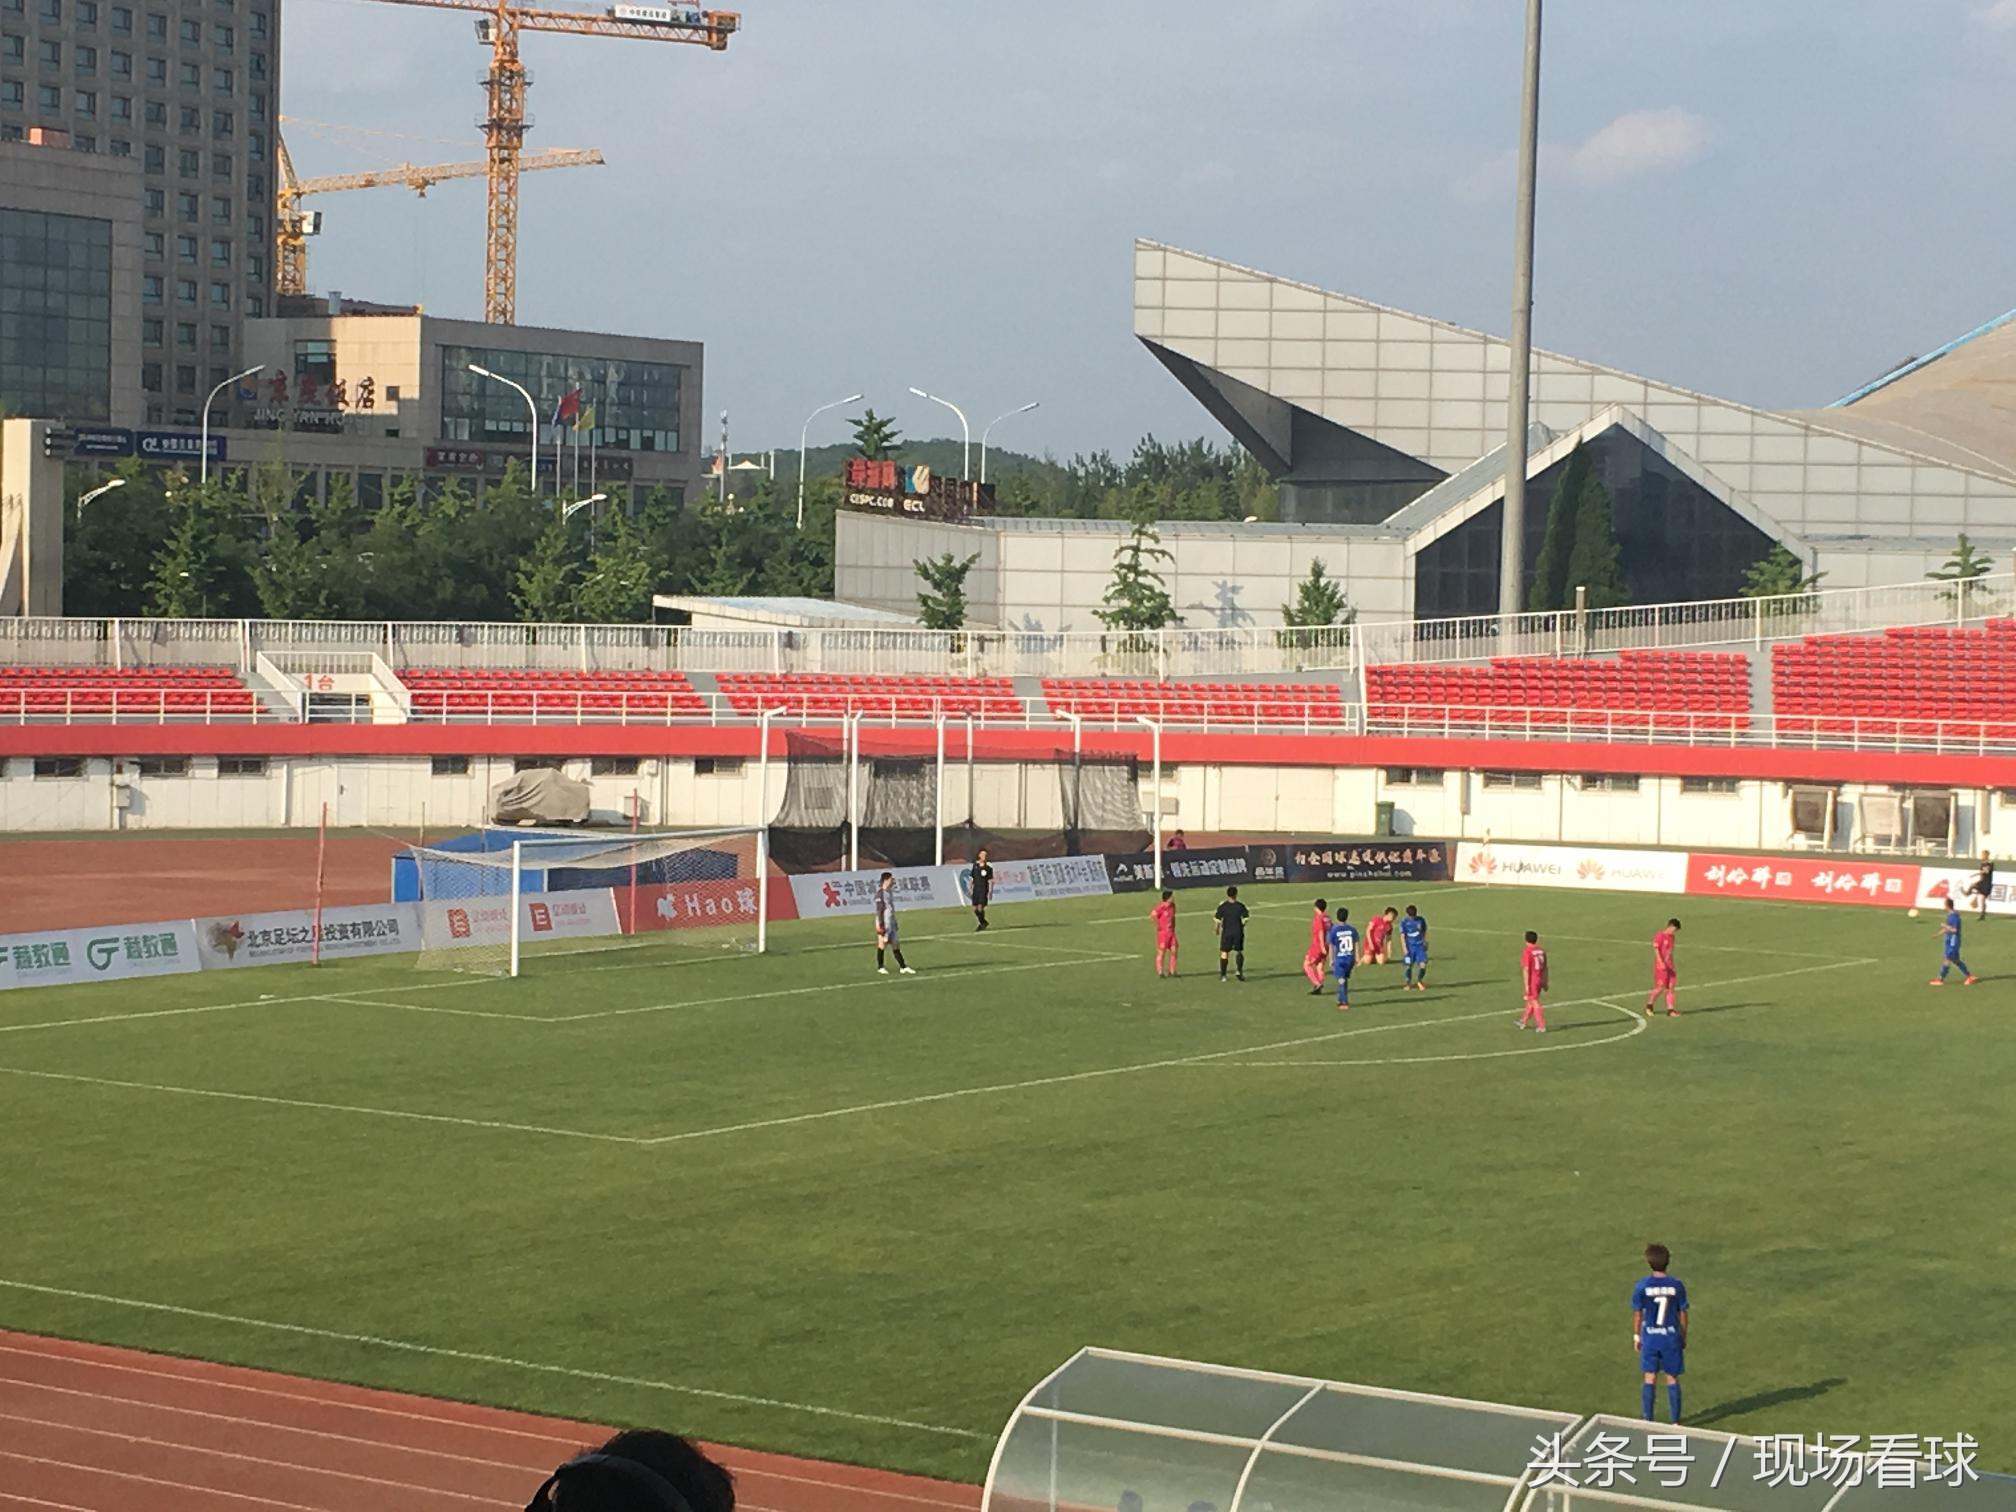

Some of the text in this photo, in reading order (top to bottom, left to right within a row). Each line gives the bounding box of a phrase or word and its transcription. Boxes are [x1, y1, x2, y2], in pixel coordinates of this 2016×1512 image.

[1502, 860, 1562, 875] HUAWEI
[1611, 868, 1668, 880] HUAWE
[1338, 936, 1353, 952] 20
[1653, 1296, 1668, 1325] 7
